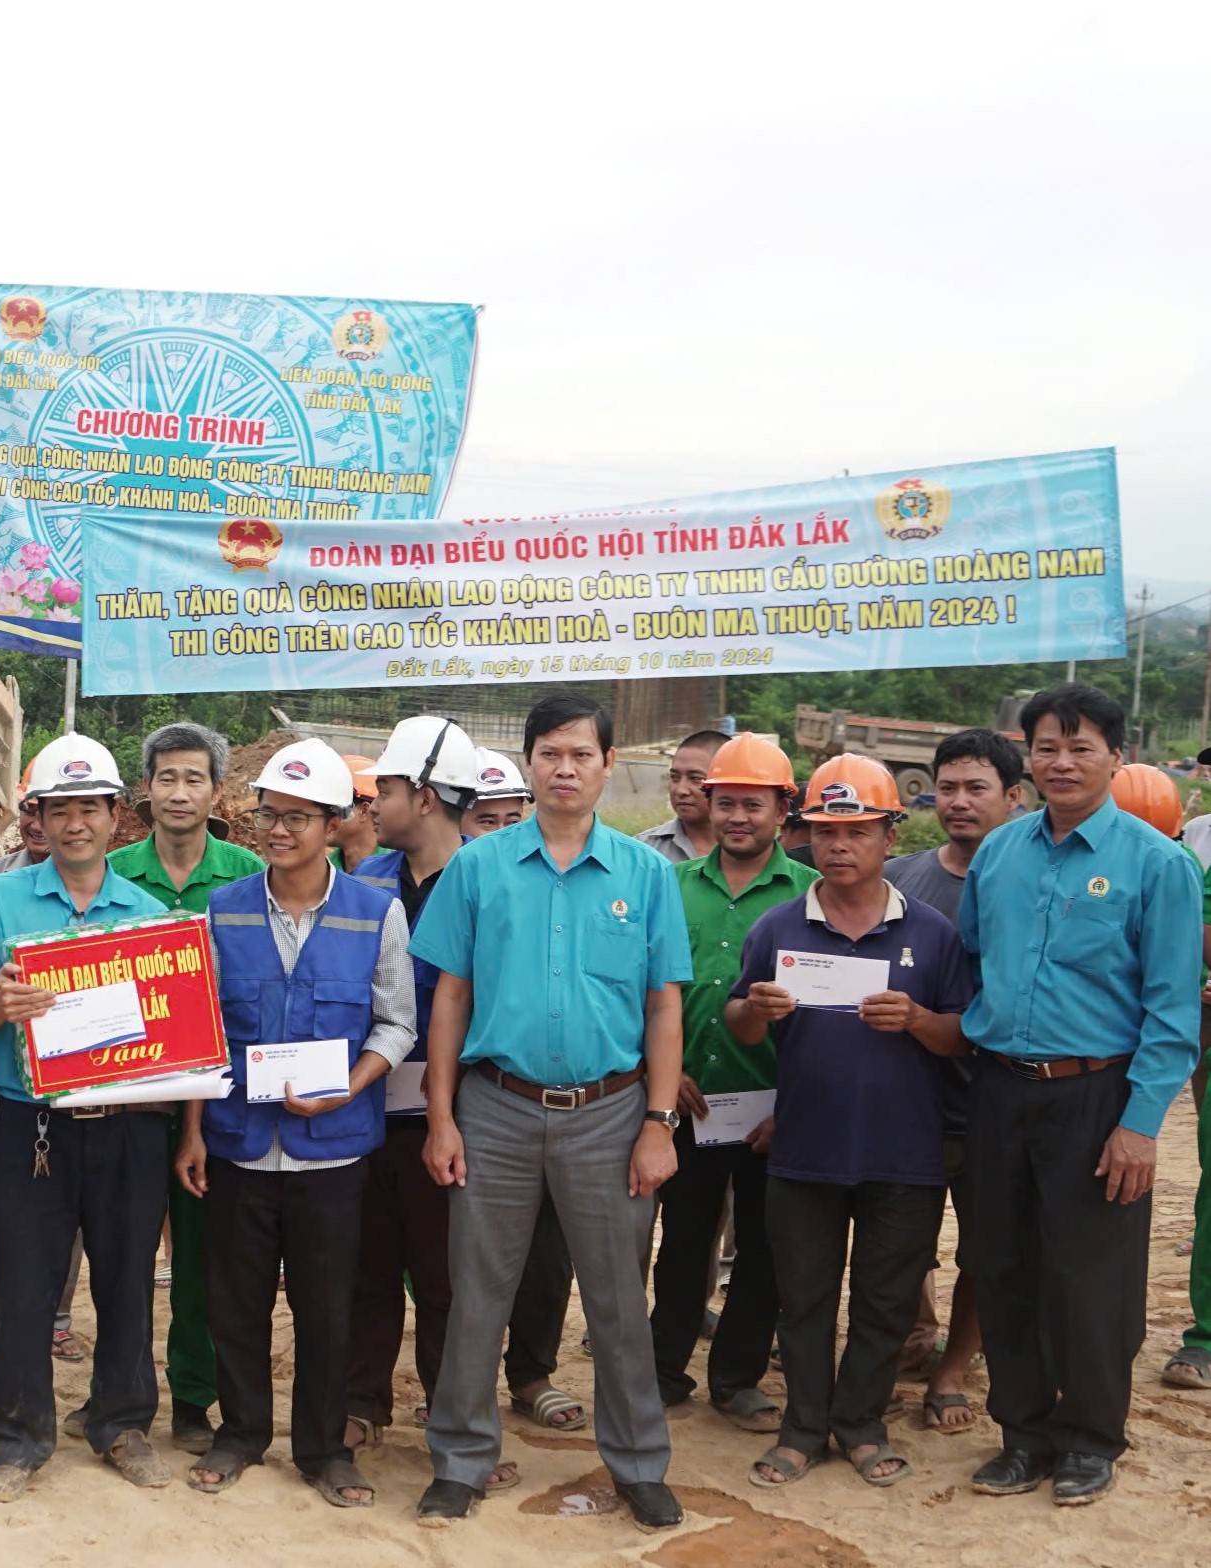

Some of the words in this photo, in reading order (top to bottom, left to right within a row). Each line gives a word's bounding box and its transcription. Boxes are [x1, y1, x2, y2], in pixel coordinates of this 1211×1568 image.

[78, 353, 101, 374] HỘI
[280, 365, 312, 383] LIÊN
[317, 367, 356, 386] ĐOÀN
[361, 372, 387, 388] LAO
[392, 372, 432, 393] ĐỘNG
[77, 409, 180, 440] CHƯƠNG
[188, 413, 266, 445] TRÌNH
[11, 443, 37, 469] QUÀ
[42, 444, 83, 470] CÔNG
[86, 448, 131, 473] NHÂN
[134, 454, 164, 476] LAO
[168, 454, 212, 482] ĐỘNG
[217, 457, 263, 484] CÔNG
[267, 464, 286, 486] TY
[290, 465, 333, 489] TNHH
[337, 466, 395, 494] HOÀNG
[398, 473, 433, 496] NAM
[11, 475, 49, 500] CÔNG
[52, 481, 82, 503] CAO
[87, 478, 115, 506] TỐC
[119, 483, 174, 511] KHÁNH
[178, 486, 211, 513] HOÀ
[226, 492, 272, 517] BUÔN
[275, 499, 302, 520] MA
[309, 541, 382, 568] ĐOÀN
[391, 543, 435, 570] ĐẠI
[444, 531, 505, 564] BIỂU
[515, 527, 588, 563] QUỐC
[598, 528, 644, 561] HỘI
[653, 522, 719, 554] TỈNH
[728, 515, 786, 550] ĐẮK
[796, 511, 850, 546] LẮK
[96, 587, 169, 620] THĂM,
[175, 585, 238, 621] TẶNG
[244, 581, 294, 616] QUÀ
[300, 580, 367, 612] CÔNG
[372, 577, 443, 609] NHÂN
[449, 579, 496, 606] LAO
[501, 574, 573, 609] ĐỘNG
[579, 570, 651, 600] CÔNG
[657, 571, 689, 597] TY
[694, 567, 765, 595] TNHH
[833, 554, 928, 588] ĐƯỜNG
[934, 548, 1031, 584] HOÀNG
[1037, 547, 1105, 578] NAM
[169, 629, 208, 656] THI
[213, 622, 279, 655] CÔNG
[285, 620, 348, 652] TRÊN
[354, 621, 404, 649] CAO
[409, 612, 458, 647] TỐC
[464, 613, 551, 646] KHÁNH
[557, 608, 611, 643] HOÀ
[616, 624, 628, 633] -
[634, 605, 707, 640] BUÔN
[713, 607, 758, 636] MA
[763, 598, 852, 638] THUỘT,
[859, 596, 923, 630] NĂM
[930, 597, 999, 628] 2024
[387, 657, 427, 677] Đắk
[432, 657, 474, 678] Lắk,
[481, 656, 534, 678] ngày
[541, 655, 564, 673] 15
[570, 653, 631, 674] tháng
[639, 652, 663, 669] 10
[668, 650, 714, 668] năm
[721, 647, 773, 666] 2024
[99, 949, 133, 986] BIỂU
[135, 945, 174, 983] QUỐC
[176, 943, 202, 978] HỘI
[142, 987, 170, 1021] LẮK
